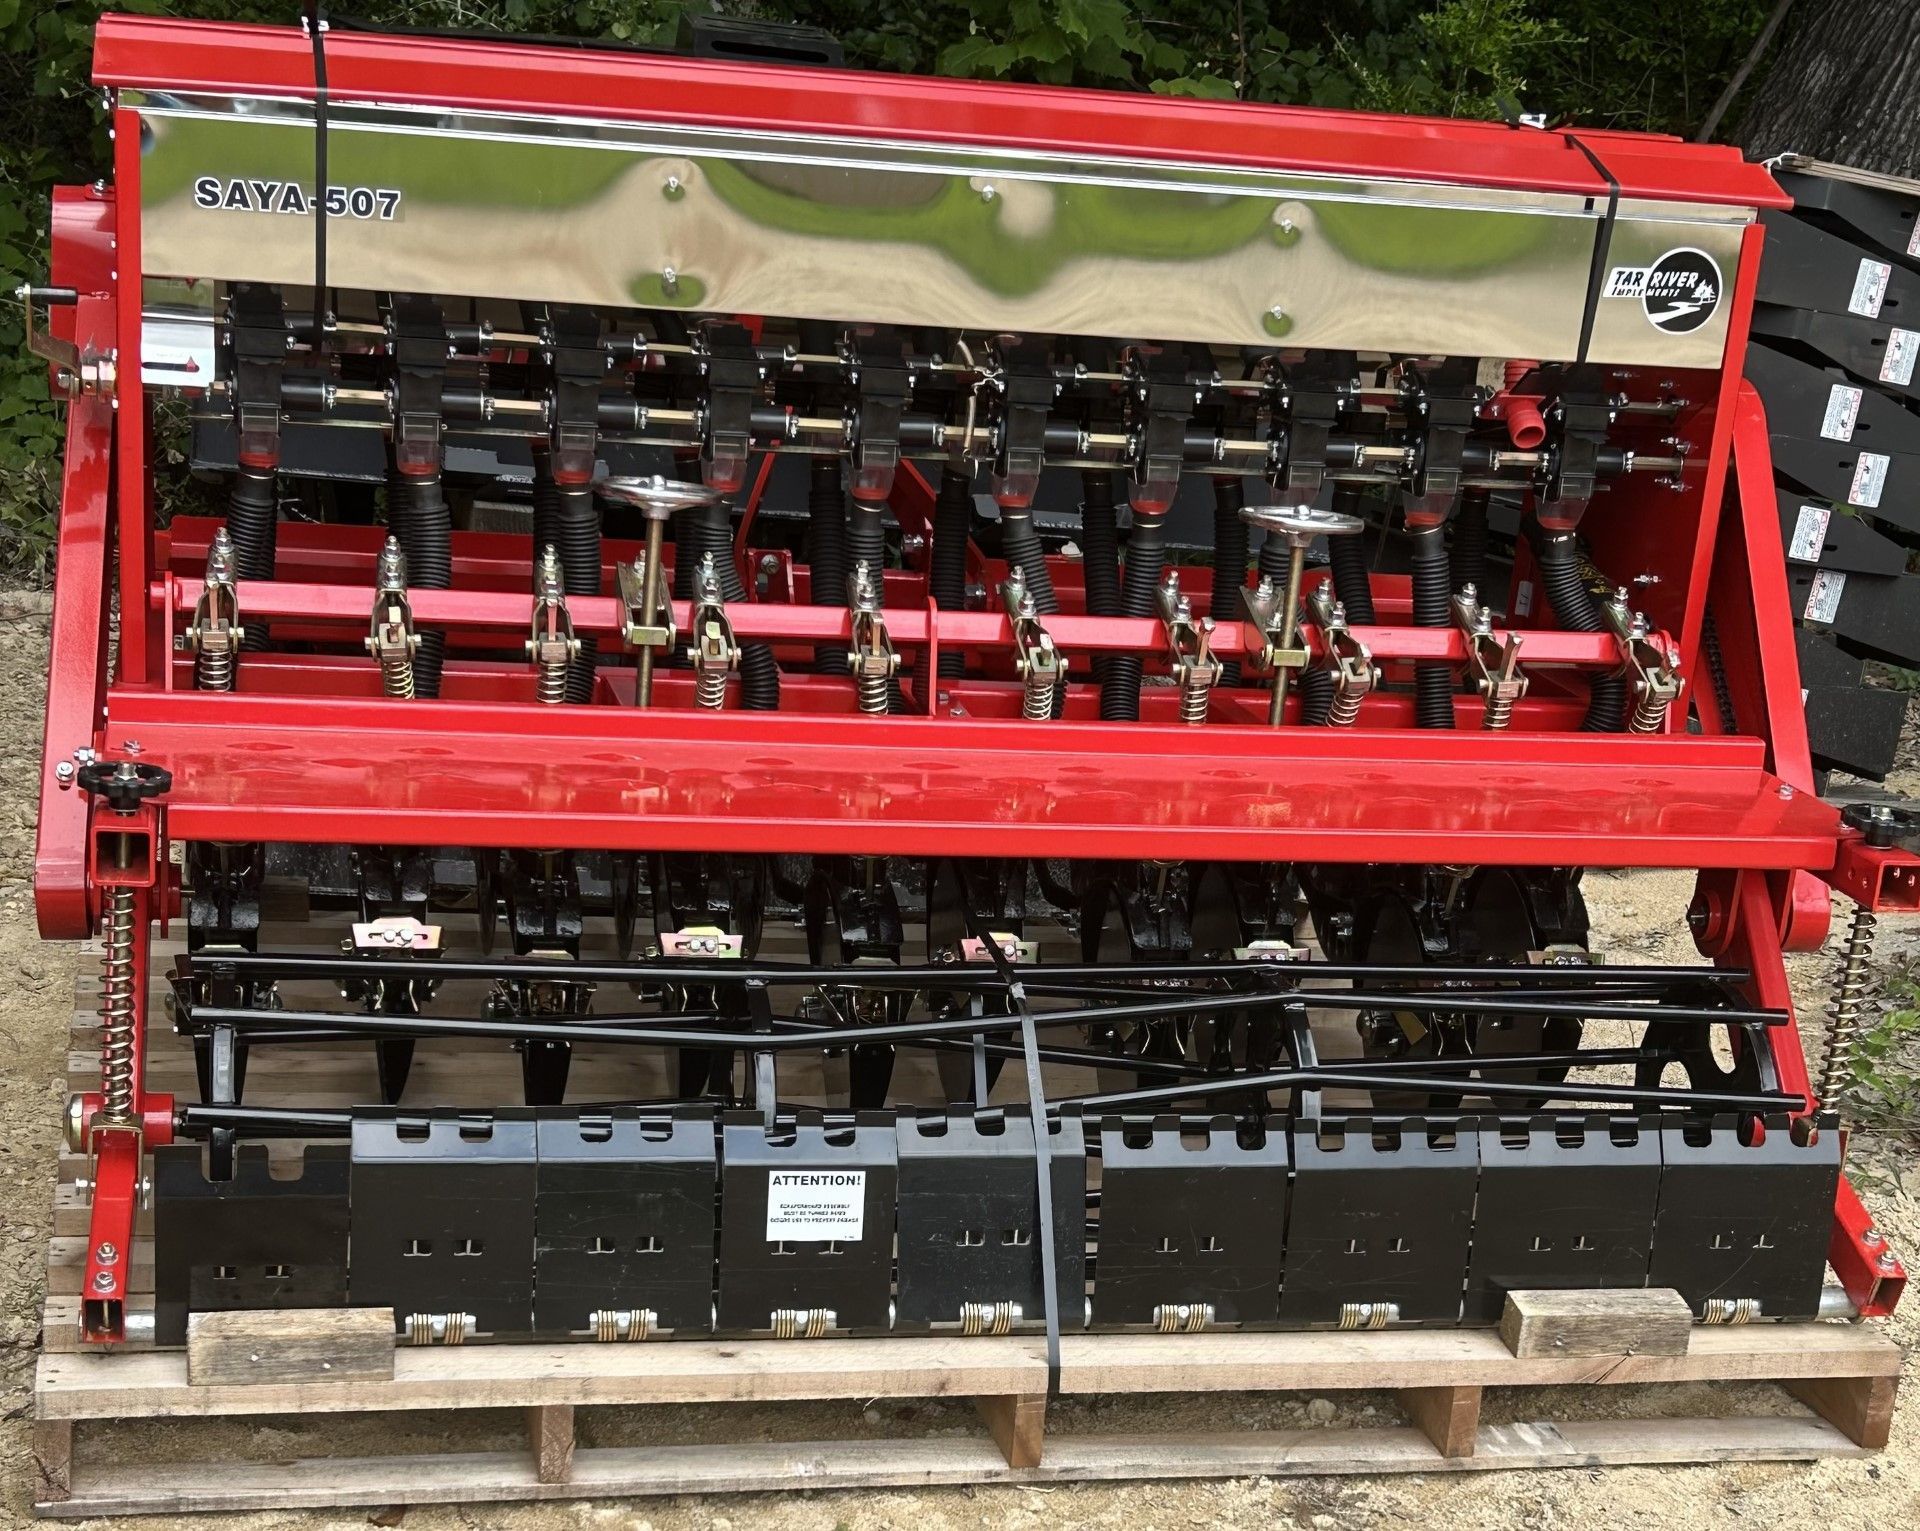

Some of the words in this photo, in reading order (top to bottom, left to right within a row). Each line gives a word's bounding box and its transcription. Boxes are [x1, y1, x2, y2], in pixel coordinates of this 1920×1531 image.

[195, 176, 401, 220] SAYA-507
[1614, 271, 1645, 287] TAR
[1650, 271, 1699, 289] RIVER
[772, 1175, 861, 1186] ATTENTION!
